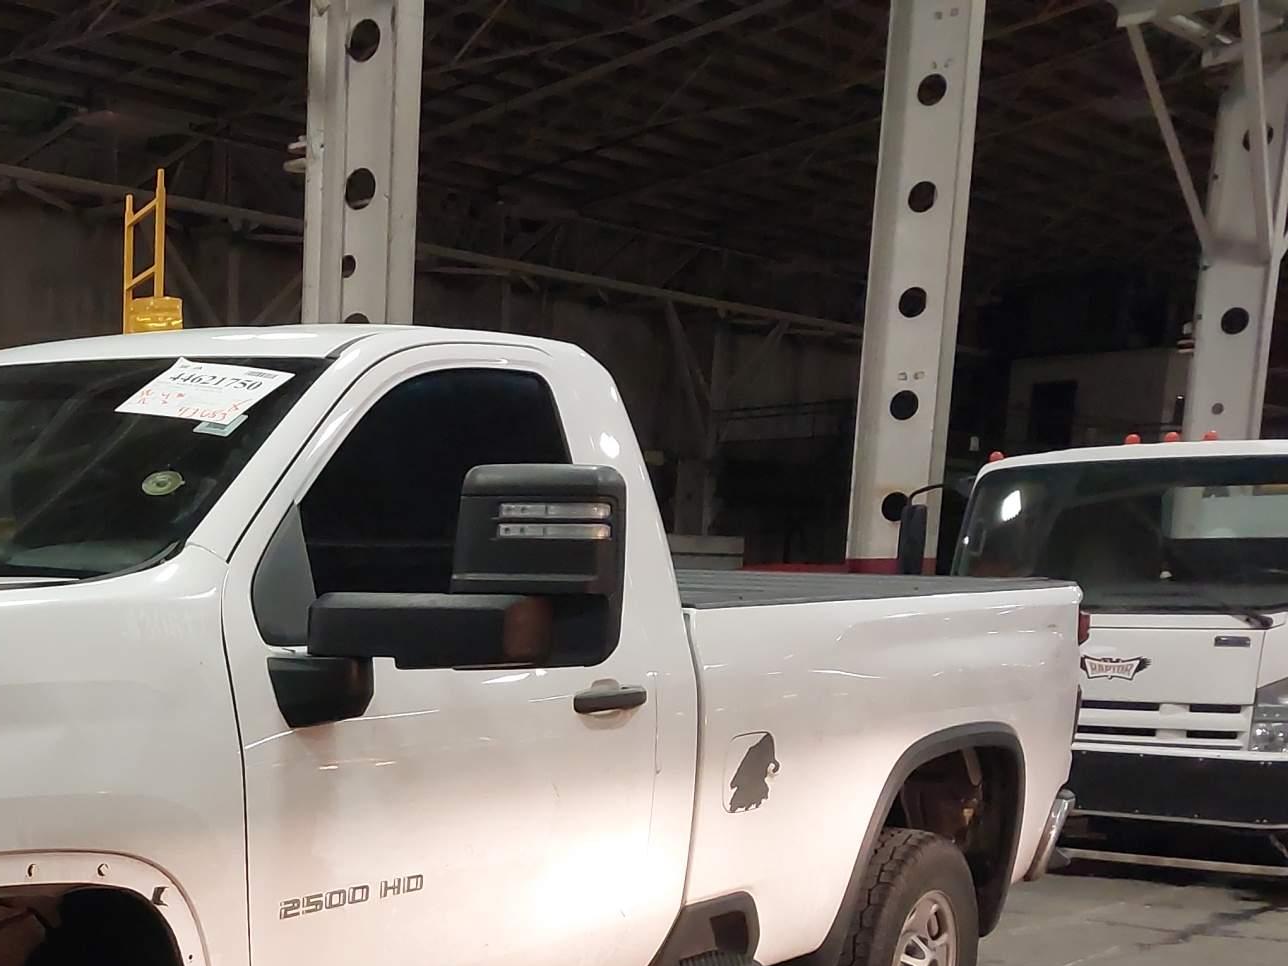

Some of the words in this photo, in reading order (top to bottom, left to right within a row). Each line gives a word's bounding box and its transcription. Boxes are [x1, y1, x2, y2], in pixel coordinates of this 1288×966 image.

[169, 373, 264, 391] 44621750
[1089, 661, 1134, 675] RAPTOR
[279, 884, 370, 920] 2500
[379, 874, 424, 899] HD
